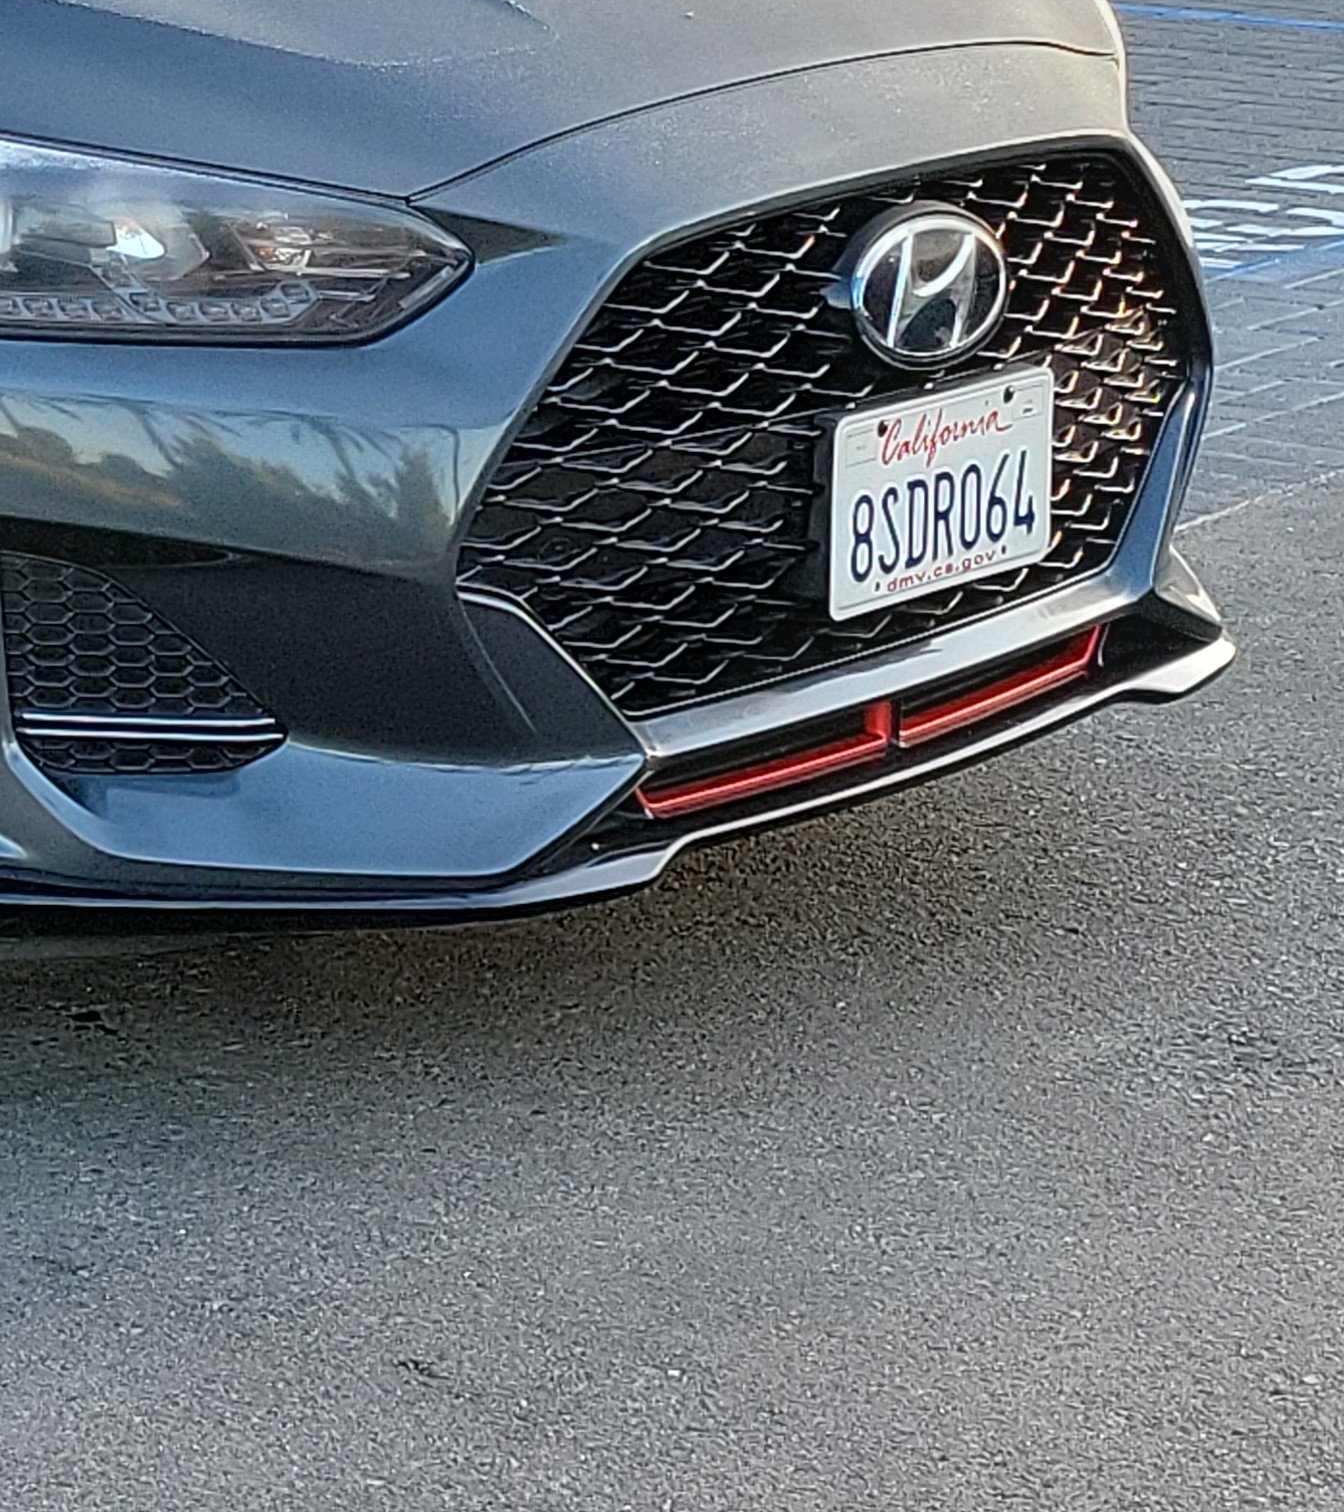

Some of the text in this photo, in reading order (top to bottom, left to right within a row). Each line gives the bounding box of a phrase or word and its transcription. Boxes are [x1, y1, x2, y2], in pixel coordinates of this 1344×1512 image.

[880, 407, 1013, 467] California
[850, 449, 1036, 583] 8SDR064
[886, 550, 997, 593] dmv.ca.gov
